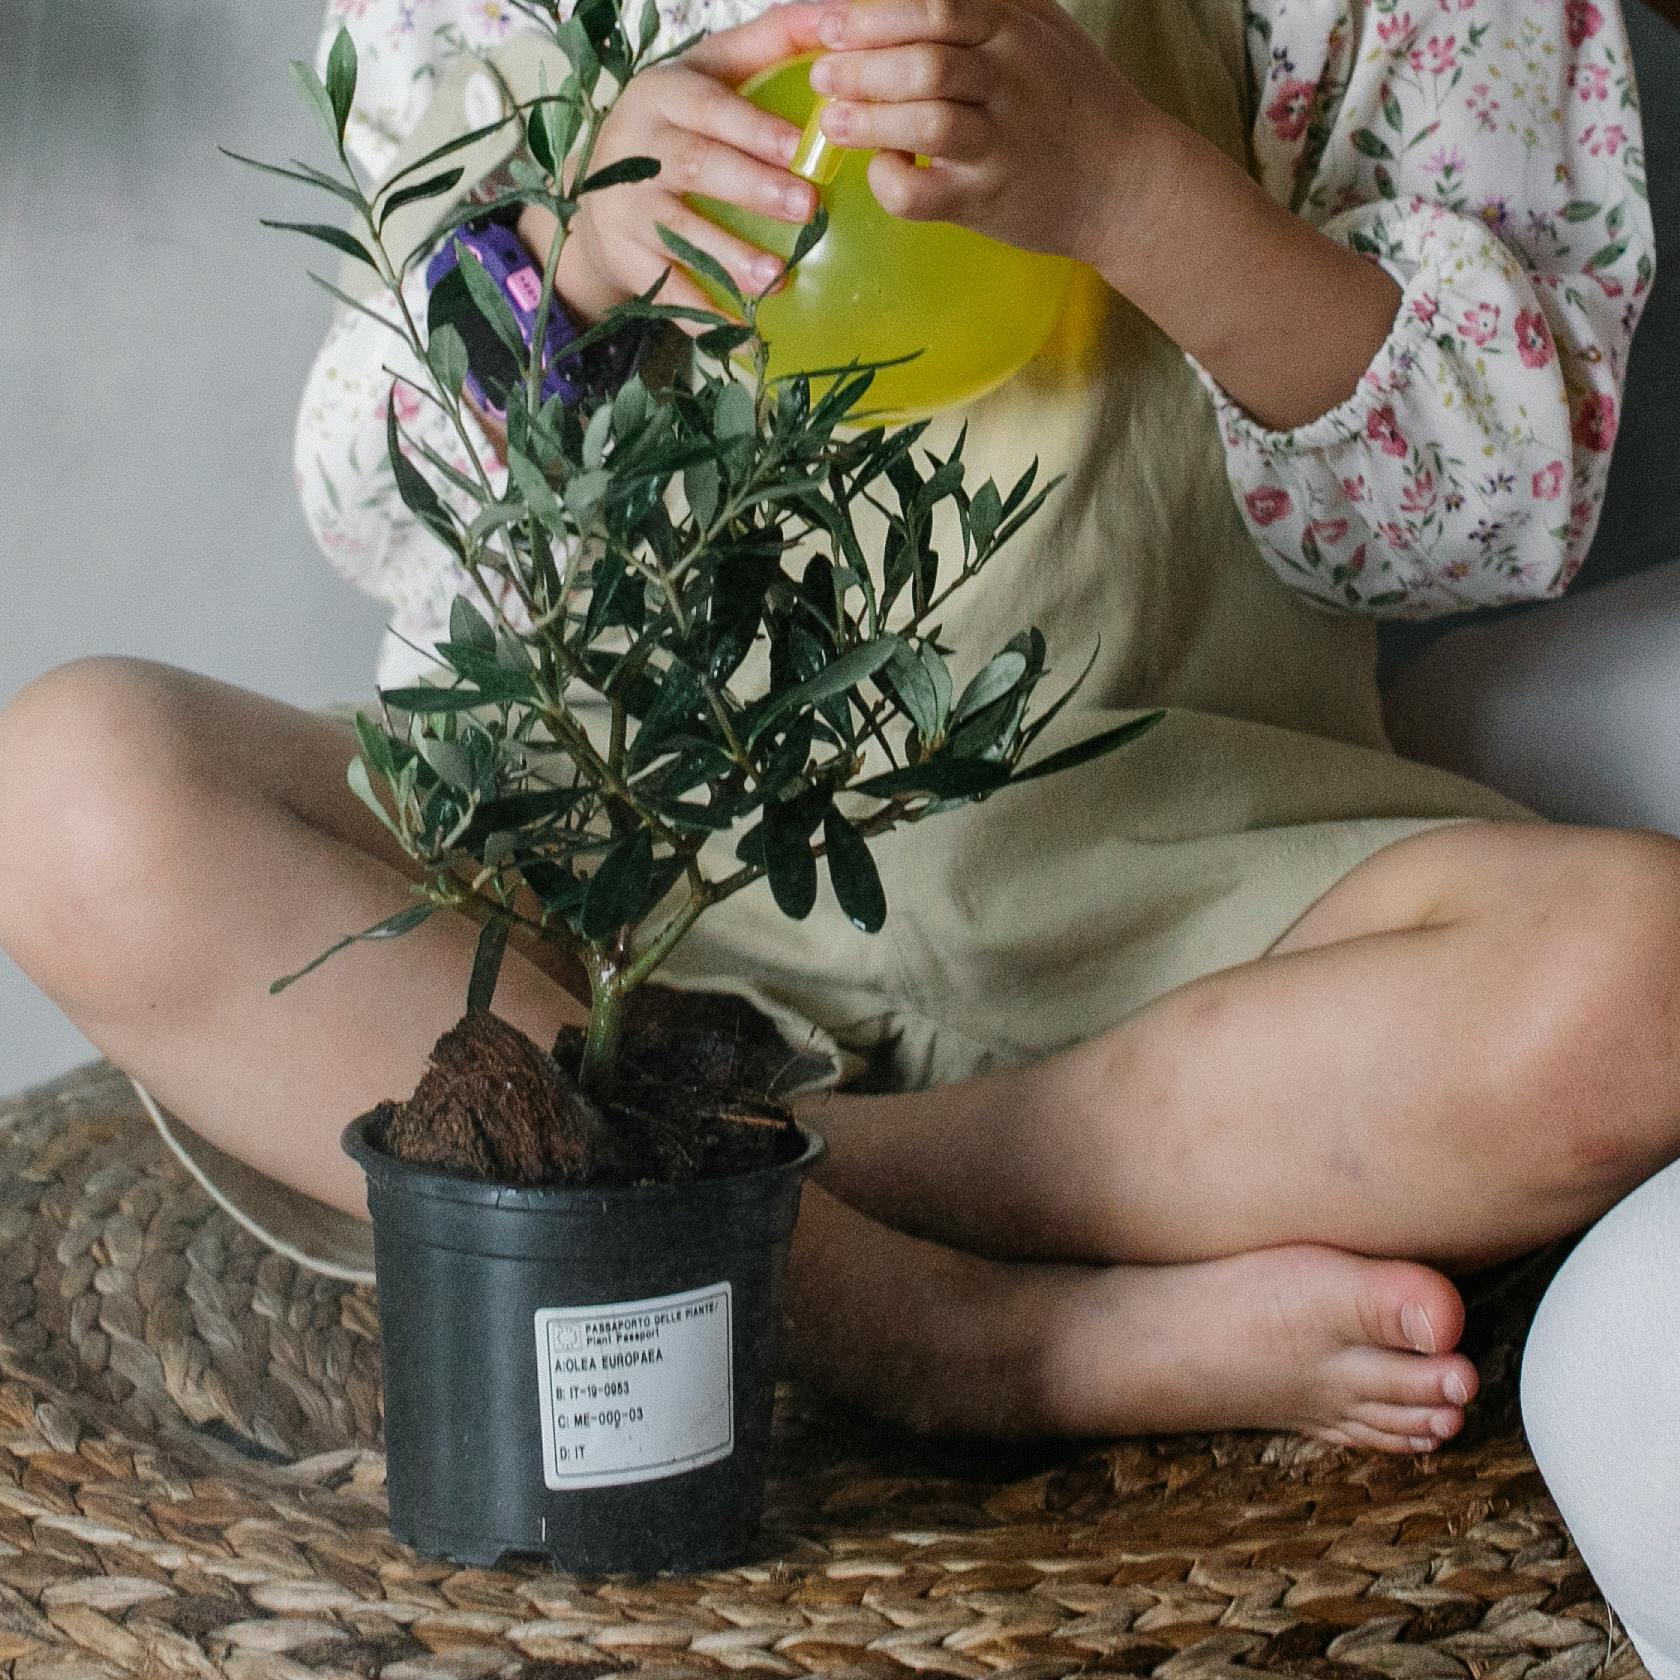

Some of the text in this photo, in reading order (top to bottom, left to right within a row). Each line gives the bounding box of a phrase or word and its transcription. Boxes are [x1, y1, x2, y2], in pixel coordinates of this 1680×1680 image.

[654, 1311, 681, 1325] DELLE
[586, 1328, 660, 1346] Plant Passport
[602, 1348, 663, 1369] EUROPAEA
[575, 1445, 585, 1459] IT
